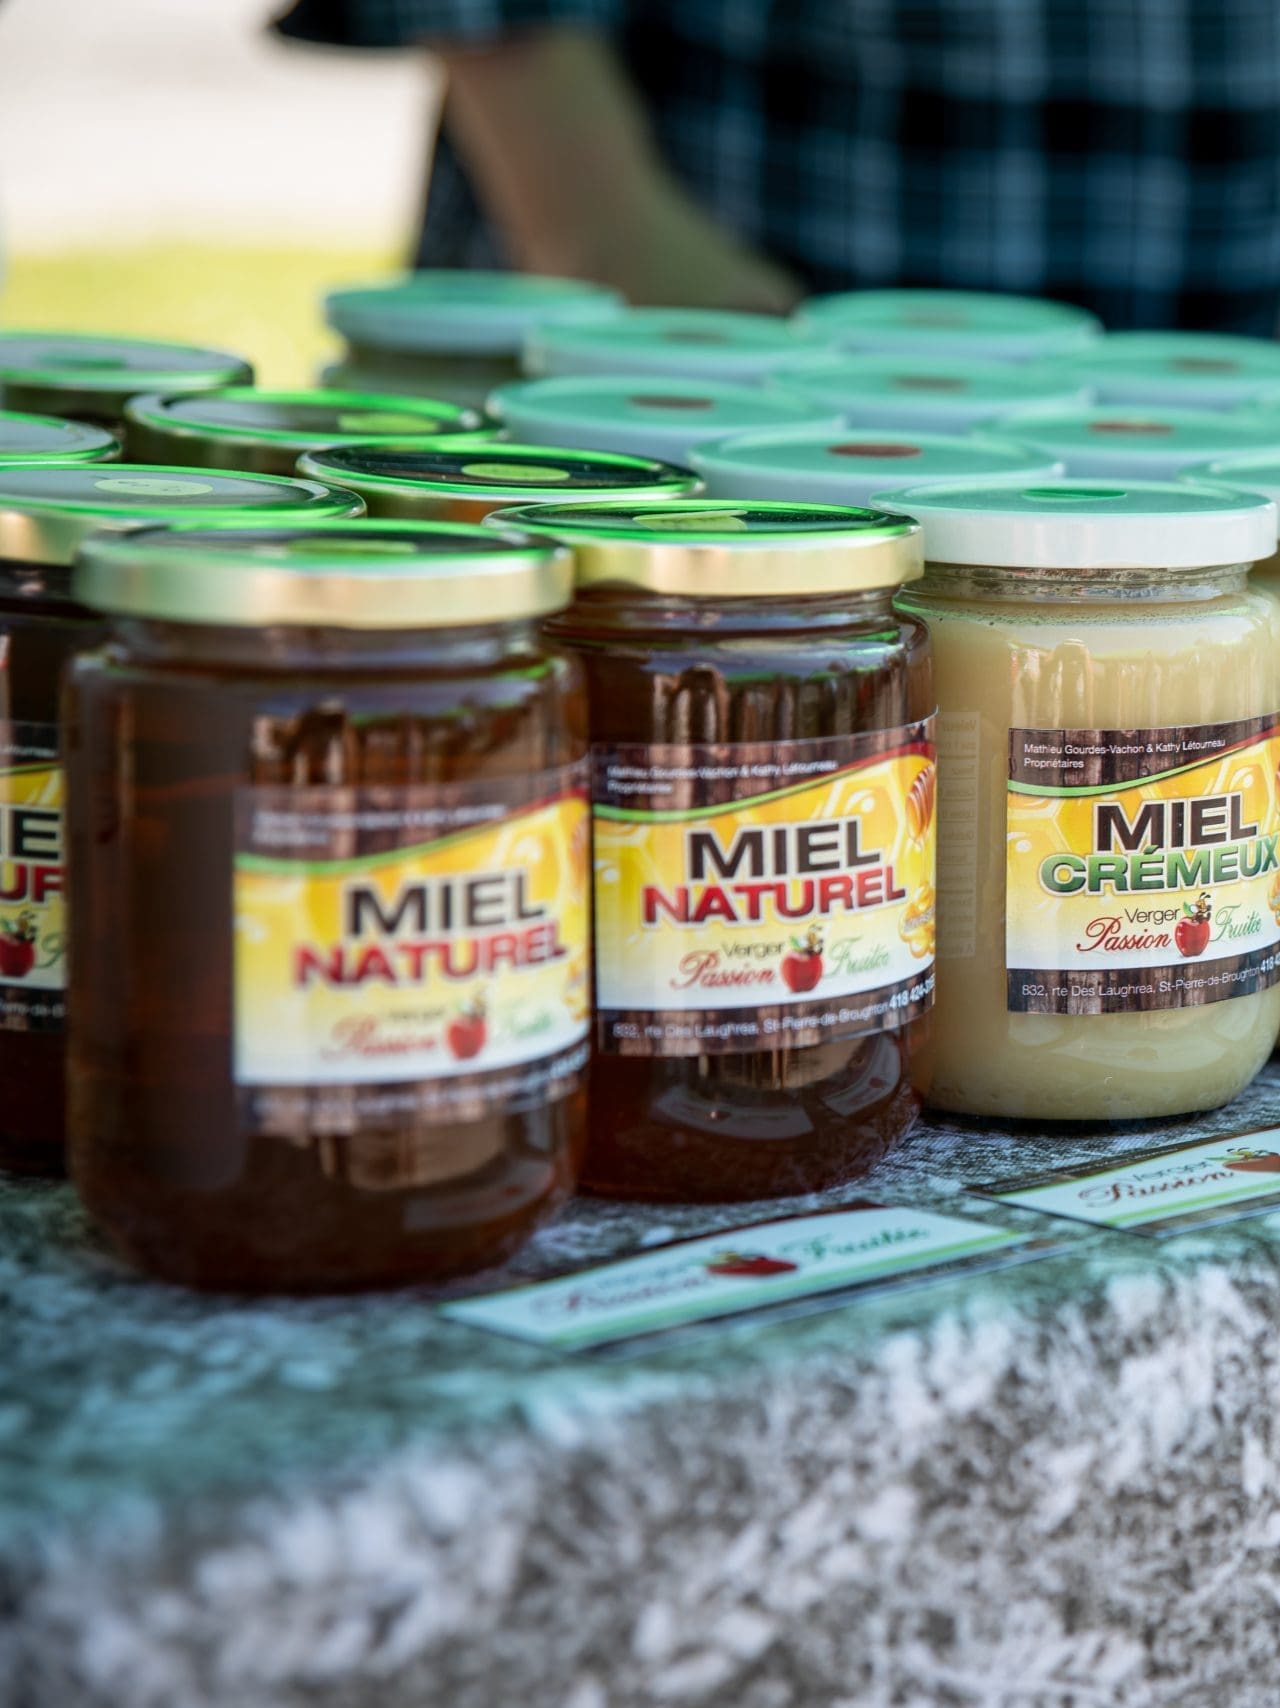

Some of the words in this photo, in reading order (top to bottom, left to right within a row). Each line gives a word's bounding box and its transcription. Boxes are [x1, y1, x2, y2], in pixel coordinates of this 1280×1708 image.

[1024, 743, 1062, 754] Mathieu
[1064, 743, 1145, 755] Gourdes-Vachon
[1146, 743, 1154, 753] &
[1156, 742, 1181, 754] Kathy
[1024, 757, 1084, 769] Propriétaires
[1097, 794, 1258, 852] MIEL
[690, 820, 880, 880] MIEL
[1041, 835, 1280, 893] CRÉMEUX
[348, 873, 546, 936] MIEL
[643, 866, 907, 923] NATUREL
[1076, 917, 1171, 952] Passion
[1124, 907, 1180, 925] Verger
[293, 922, 567, 986] NATUREL
[721, 940, 786, 958] Verger
[671, 951, 777, 989] Passion
[1022, 984, 1048, 998] 832,
[1052, 985, 1068, 998] rte
[1071, 984, 1095, 997] Des
